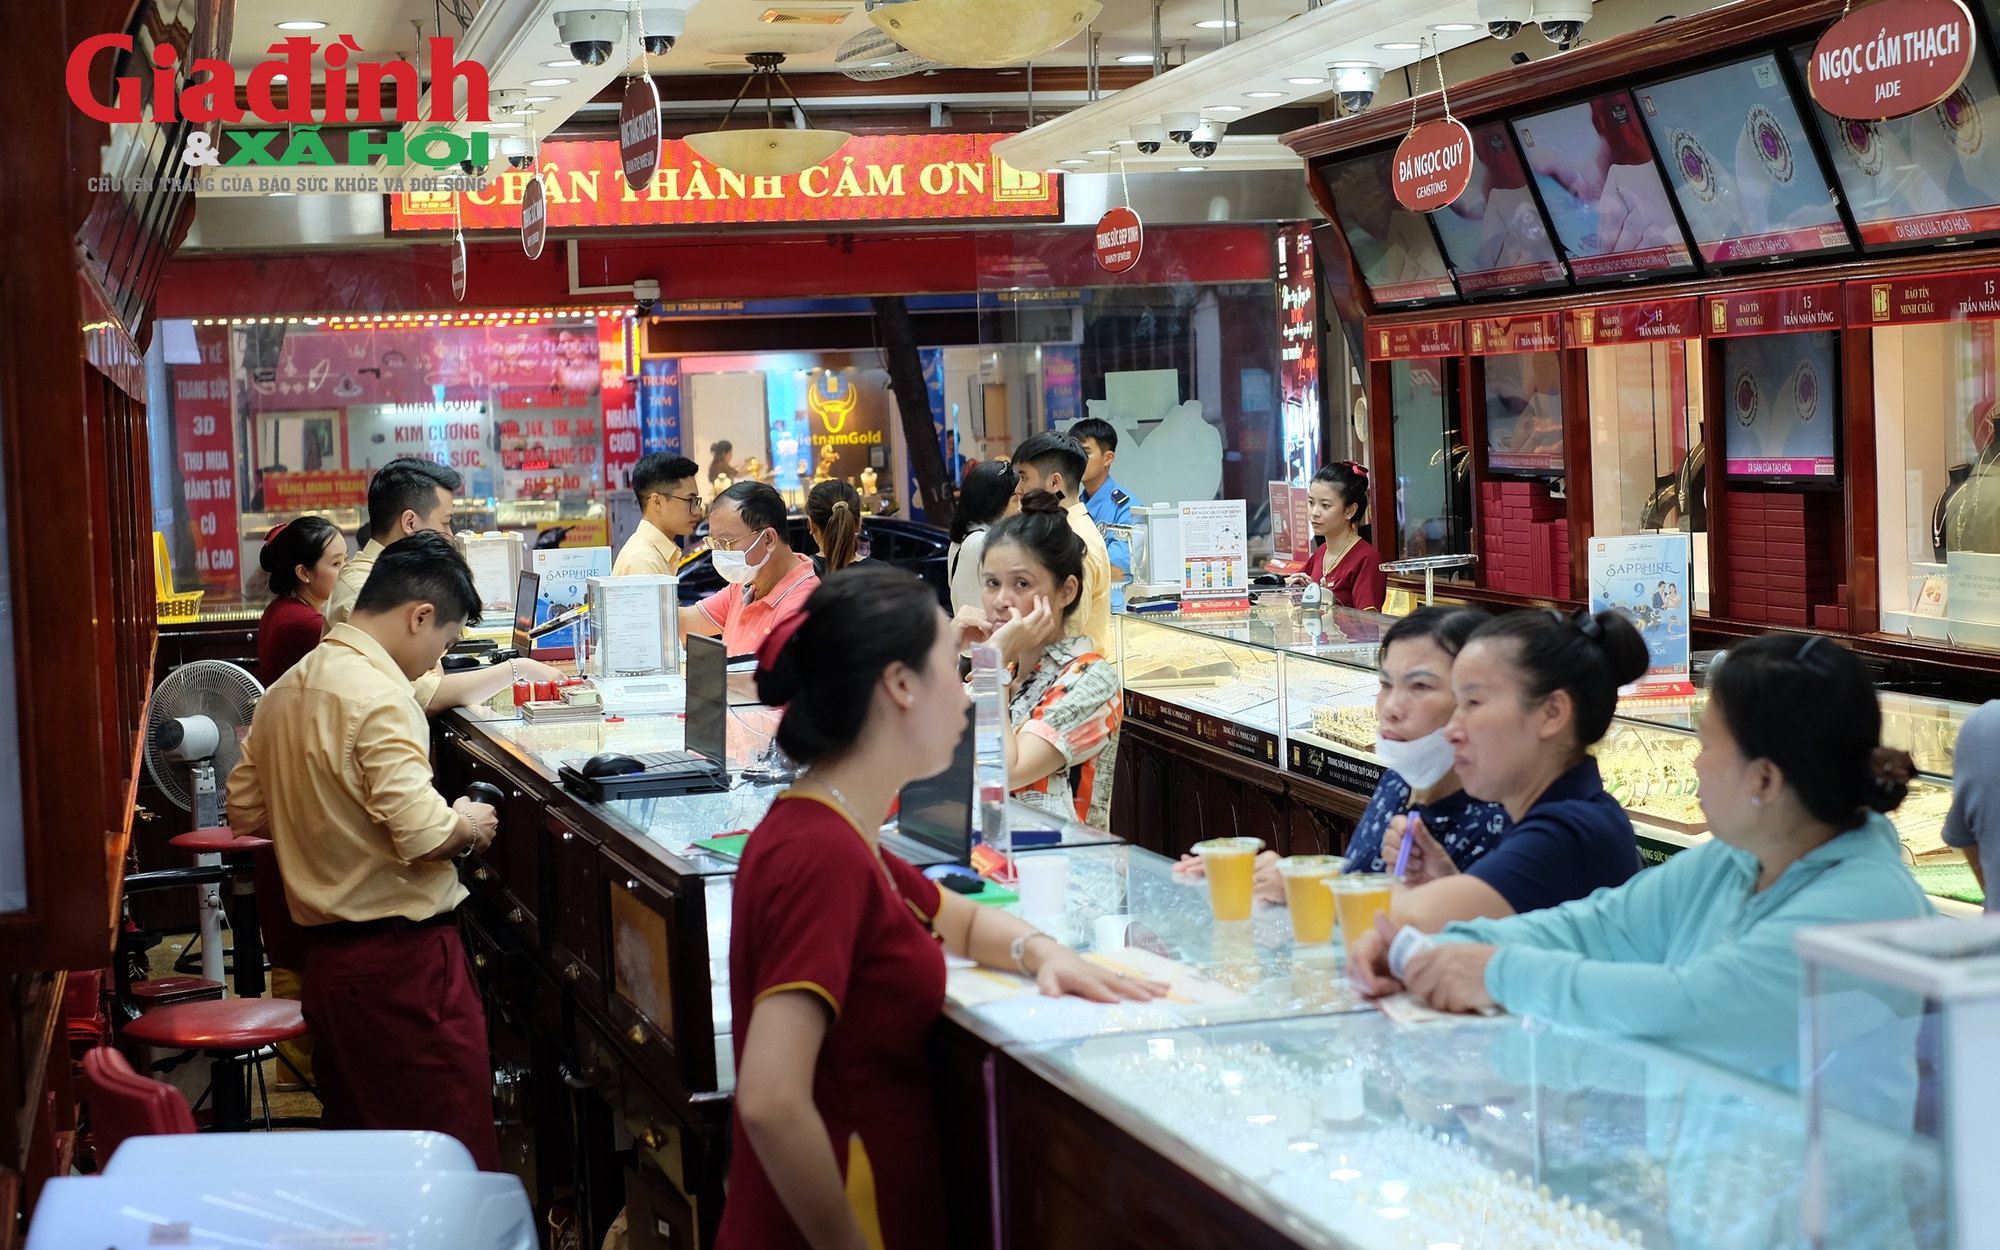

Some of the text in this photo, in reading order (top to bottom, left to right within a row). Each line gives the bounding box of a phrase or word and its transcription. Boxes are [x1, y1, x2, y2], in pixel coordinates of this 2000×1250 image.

[1819, 21, 1960, 85] NGỌC CẨM THẠCH
[1875, 79, 1901, 103] JADE
[1399, 137, 1463, 183] ĐÁ NGỌC QUÝ
[466, 162, 601, 206] CHÂN
[799, 156, 905, 198] CẢM
[920, 160, 985, 196] ƠN
[1416, 179, 1448, 199] GEMSTONES
[1921, 219, 1938, 235] CỦA
[1935, 219, 1953, 235] TẠO
[1905, 280, 1995, 300] BẢO TÍN 15
[1803, 296, 1812, 309] 15
[1900, 303, 1917, 315] MINH
[1917, 301, 1935, 314] CHÂU
[1959, 294, 1978, 314] TRẦN
[1655, 309, 1663, 322] 15
[1783, 310, 1799, 326] TRẦN
[1798, 311, 1817, 324] NHÂN
[1817, 310, 1834, 323] TÔNG
[1432, 330, 1438, 340] 15
[1534, 322, 1540, 333] 15
[177, 379, 208, 400] TRANG
[642, 375, 677, 386] TRUNG
[192, 416, 216, 436] 3D
[395, 425, 423, 443] KIM
[183, 450, 229, 471] THU MUA
[184, 477, 212, 500] VÀNG
[211, 548, 234, 570] CAO
[546, 569, 599, 580] SAPPHIRE
[1606, 562, 1681, 577] SAPPHIRE
[569, 585, 578, 597] 9
[1633, 582, 1645, 598] 9
